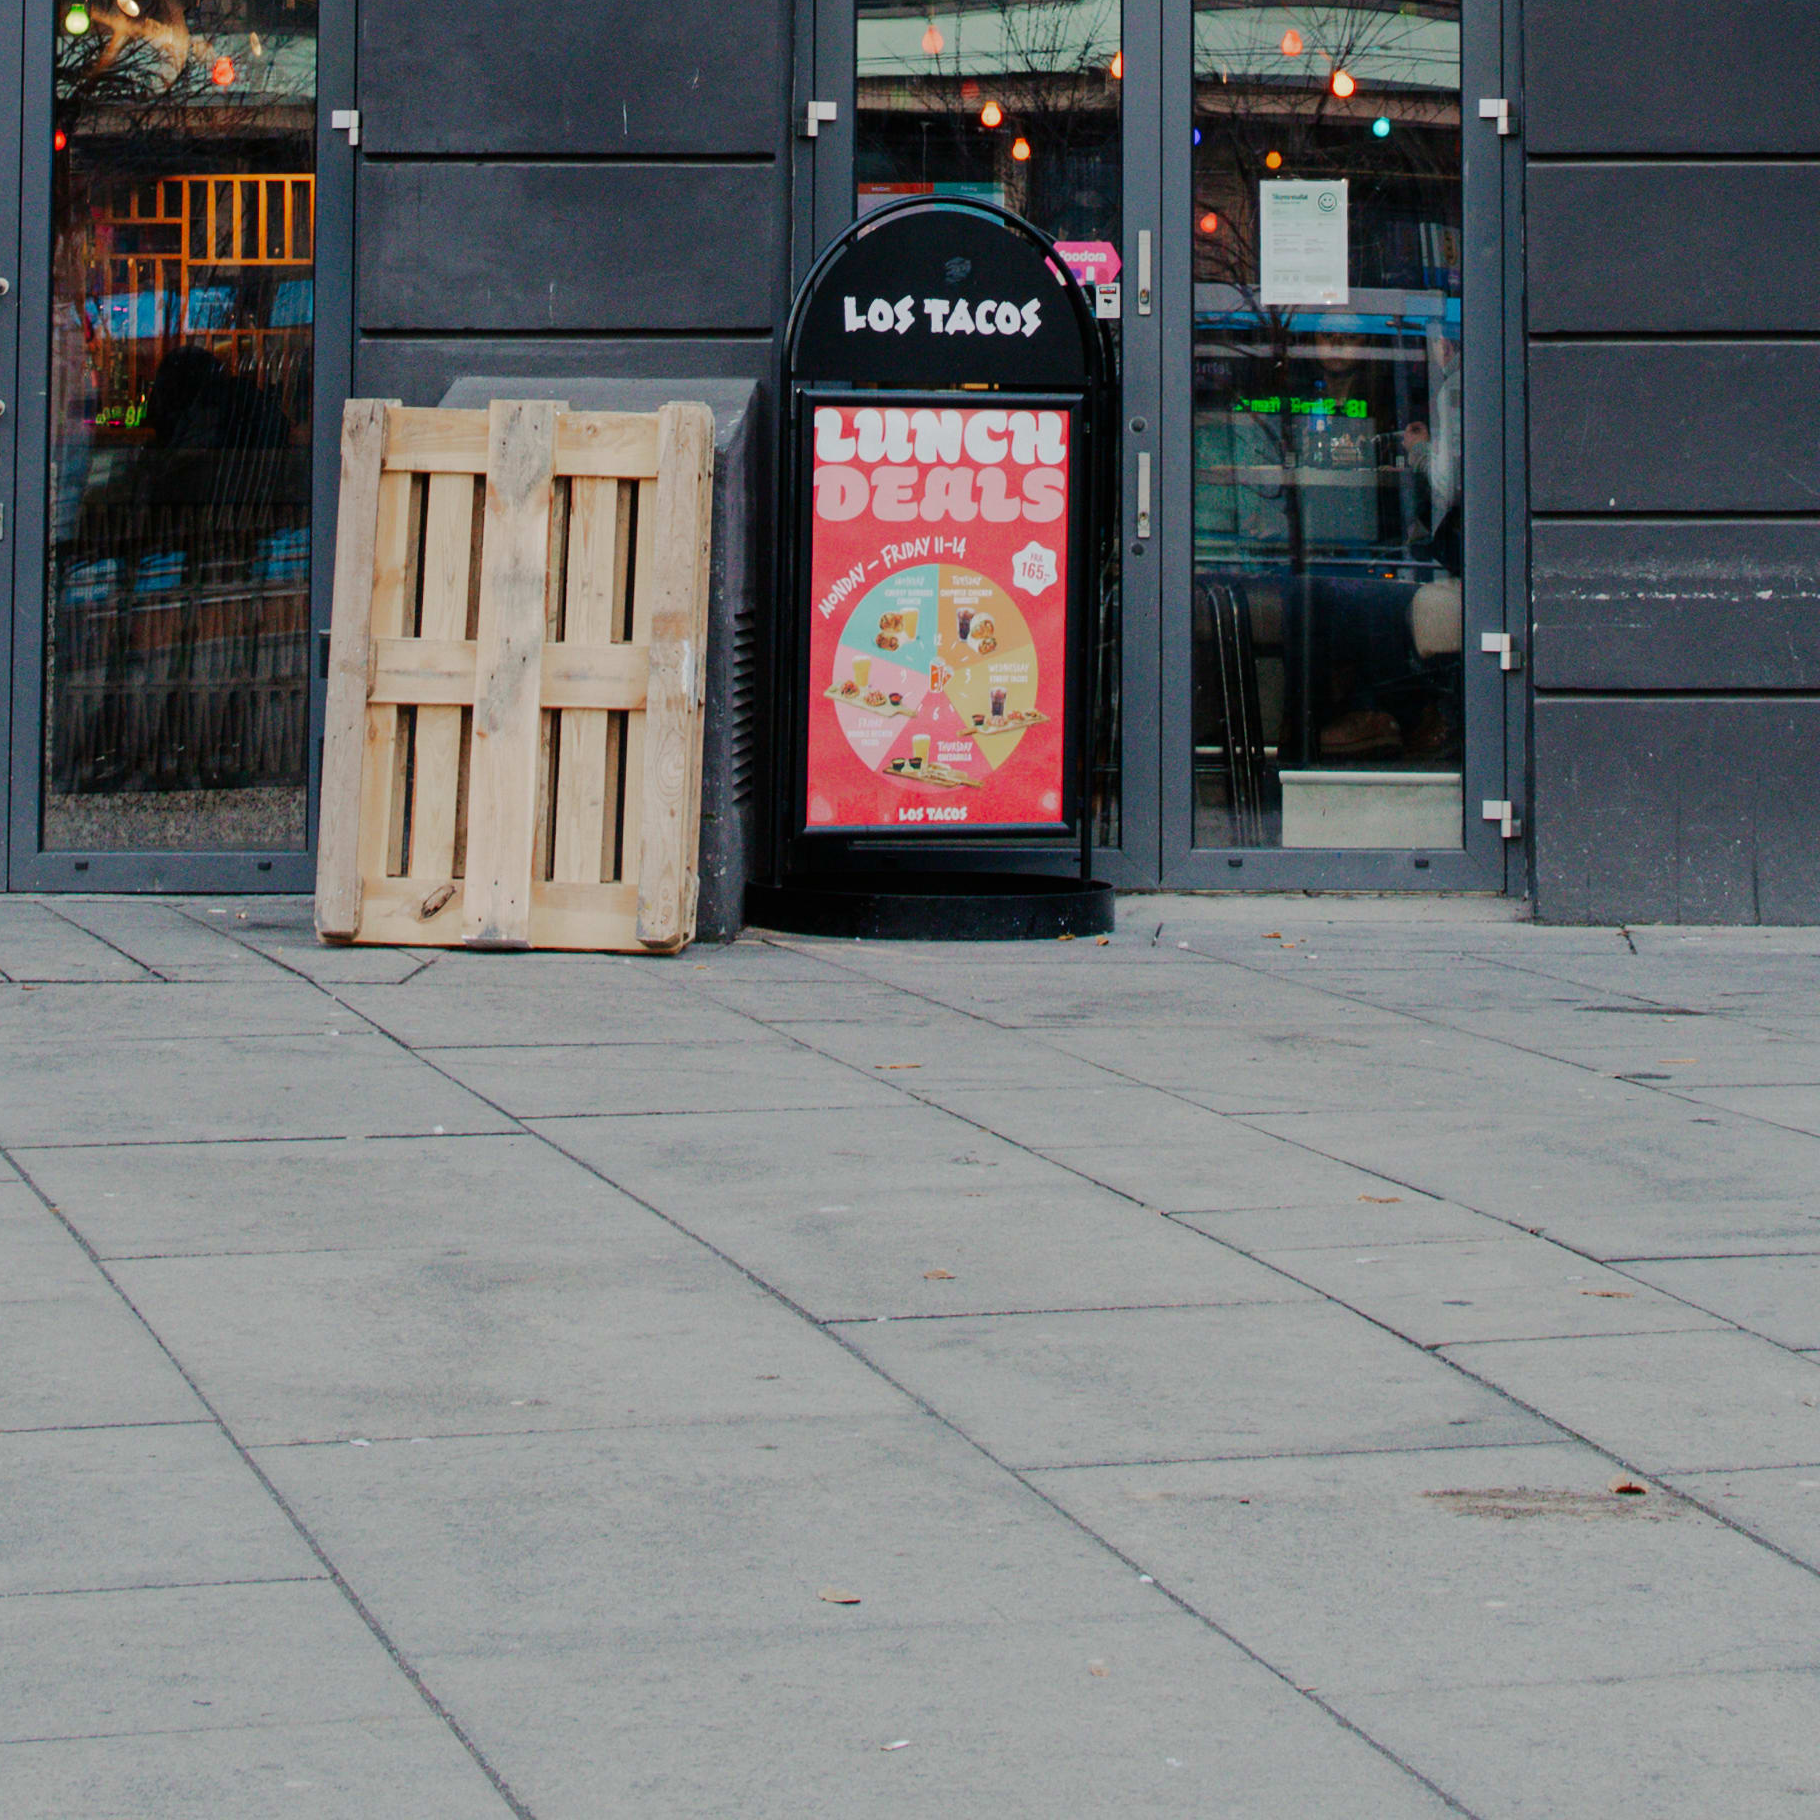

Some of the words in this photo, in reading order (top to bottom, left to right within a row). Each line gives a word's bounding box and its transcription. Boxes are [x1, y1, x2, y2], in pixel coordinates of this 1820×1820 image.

[844, 295, 915, 335] LOS
[923, 297, 1042, 338] TACOS
[814, 408, 1067, 465] LUNCH
[813, 464, 1066, 523] DEALS
[880, 536, 931, 569] FRIDAY
[899, 806, 925, 821] LOS
[926, 805, 968, 821] TACOS
